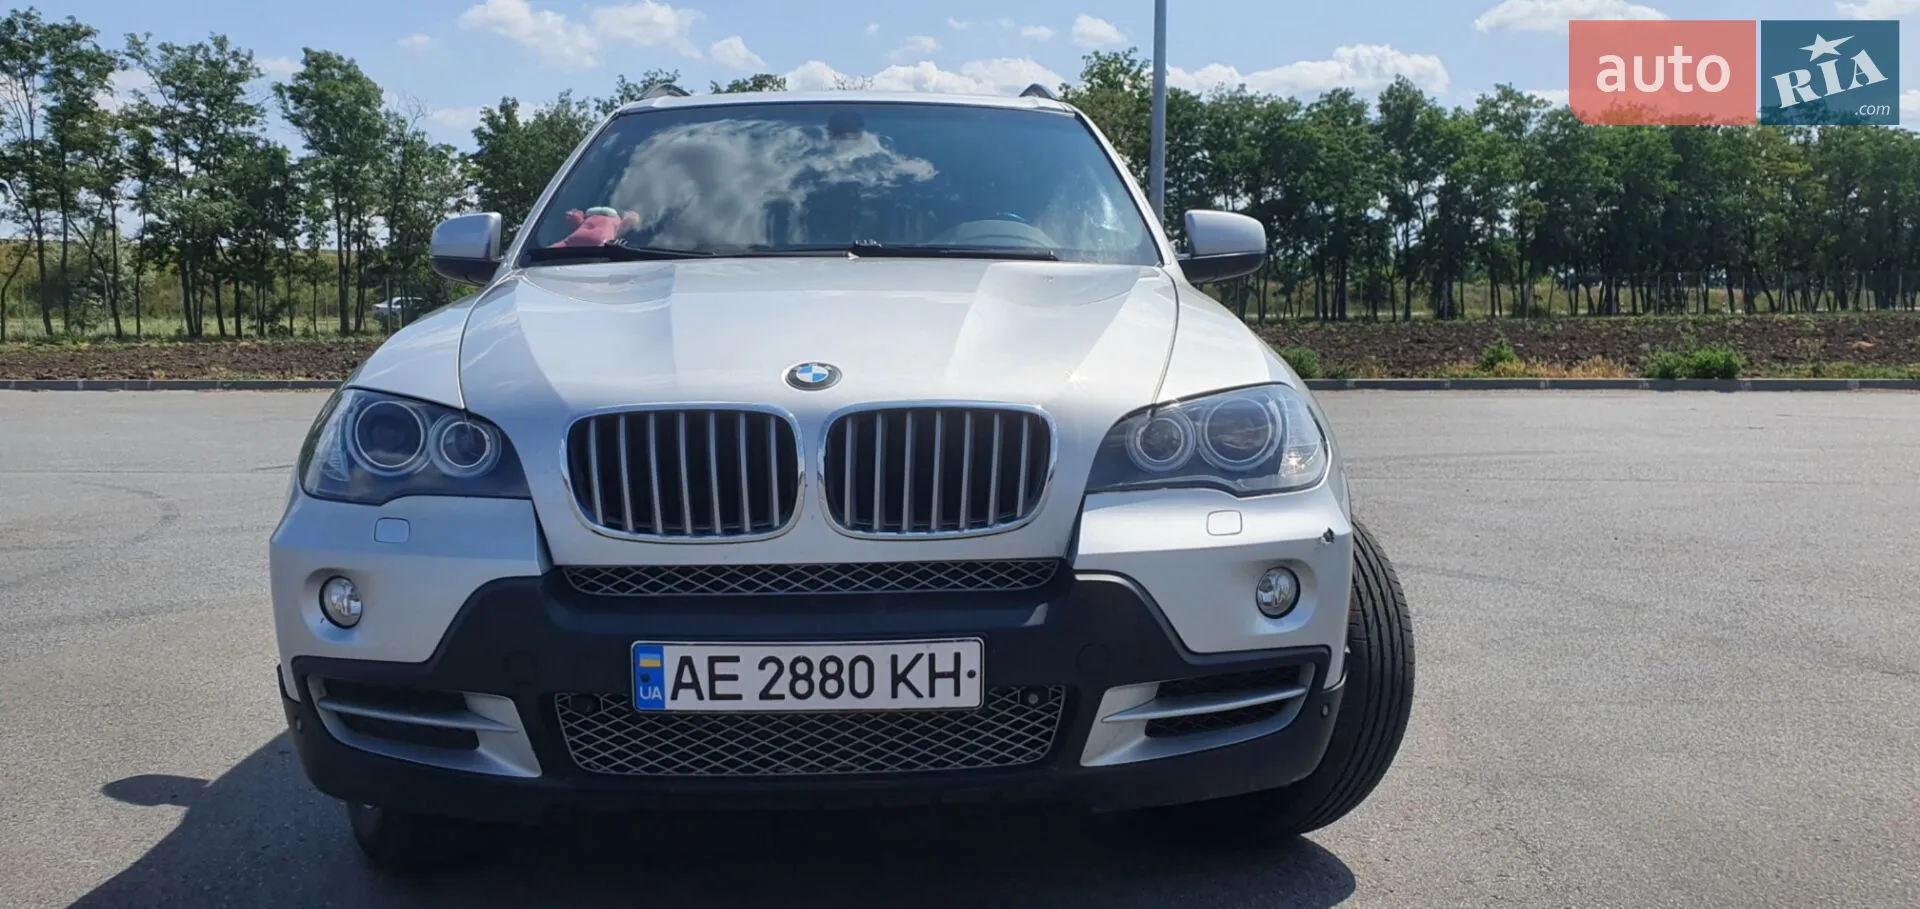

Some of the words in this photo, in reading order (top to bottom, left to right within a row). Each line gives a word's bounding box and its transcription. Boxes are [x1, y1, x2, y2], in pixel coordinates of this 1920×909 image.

[670, 655, 743, 701] AE
[758, 654, 875, 701] 2880
[890, 651, 962, 700] KH
[639, 685, 663, 701] UA
